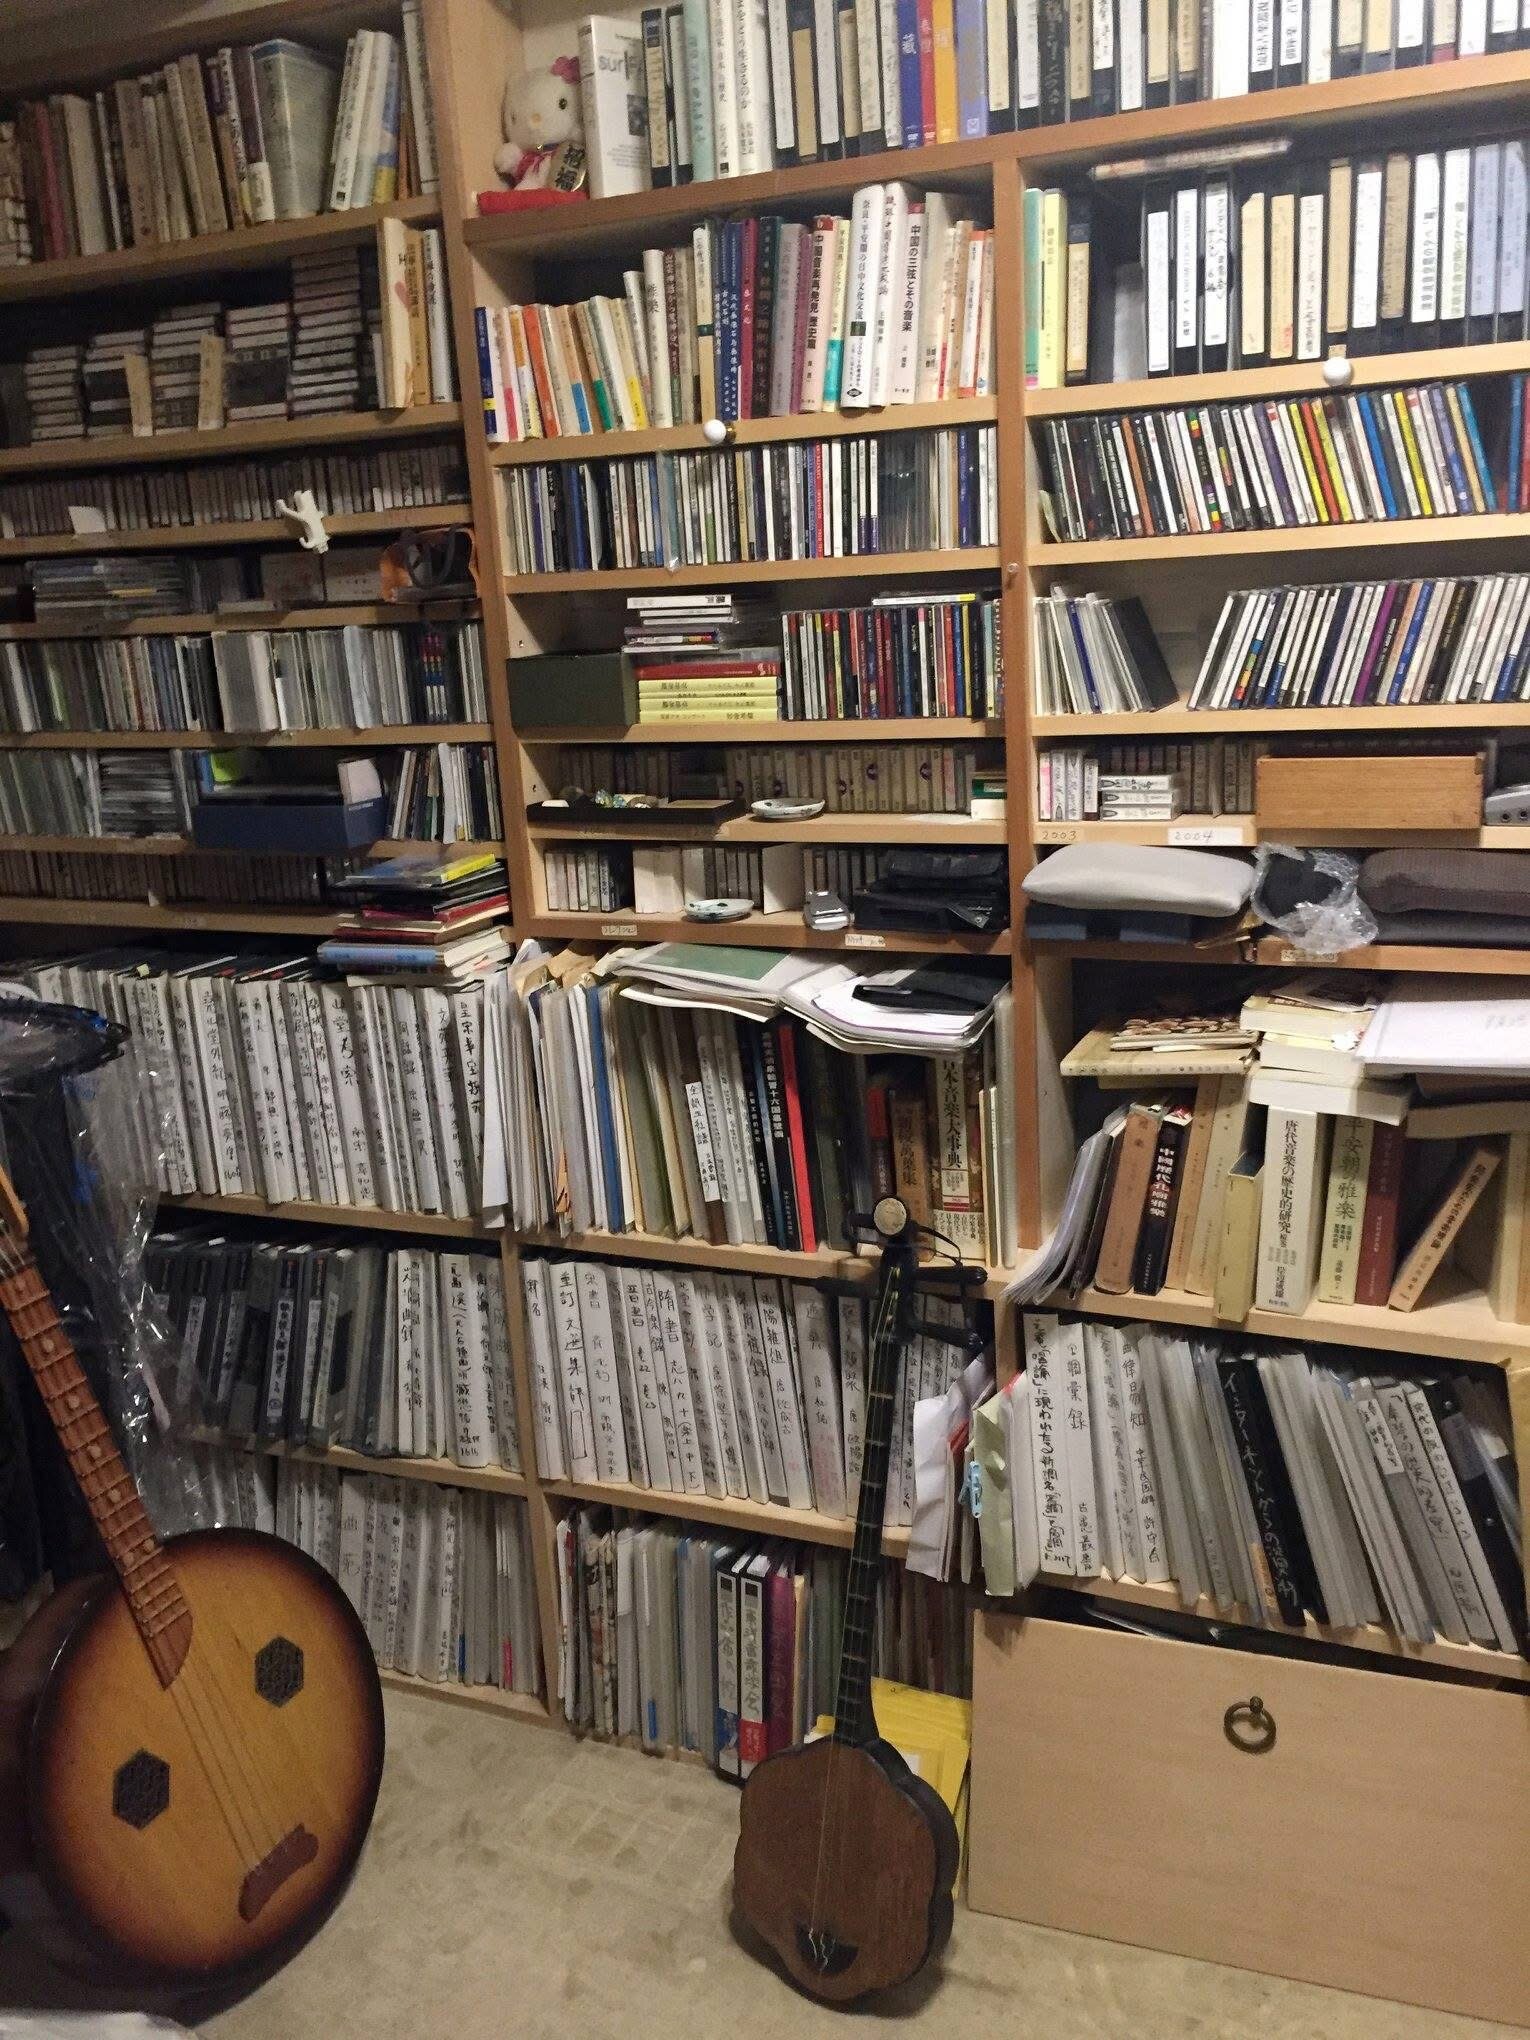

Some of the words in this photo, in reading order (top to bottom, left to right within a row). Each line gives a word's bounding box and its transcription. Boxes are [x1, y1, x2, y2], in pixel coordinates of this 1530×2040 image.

[902, 224, 921, 332] 中国の三弦とその音楽
[1042, 831, 1077, 841] 2003
[1174, 831, 1214, 841] 2004
[943, 1060, 963, 1169] 日本音楽大事典
[1278, 1119, 1299, 1234] 唐代音楽の歴史的研究
